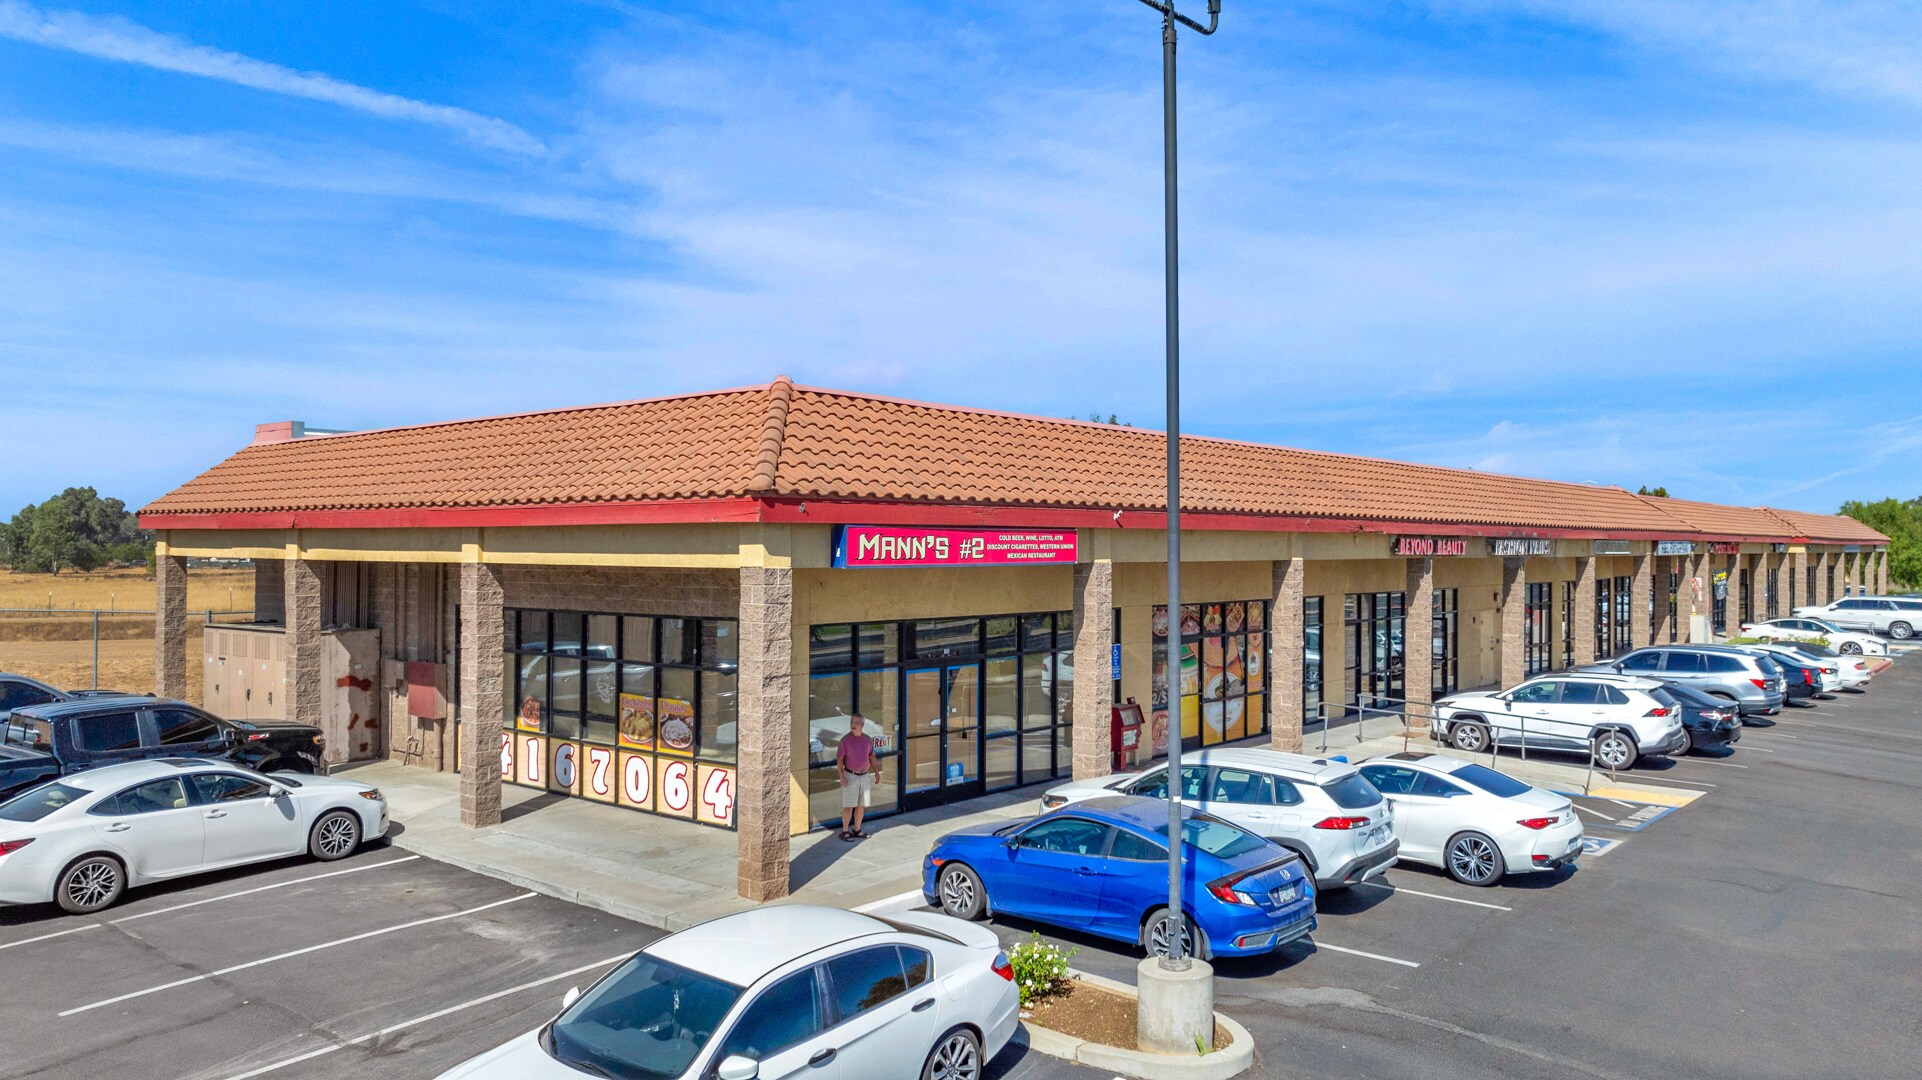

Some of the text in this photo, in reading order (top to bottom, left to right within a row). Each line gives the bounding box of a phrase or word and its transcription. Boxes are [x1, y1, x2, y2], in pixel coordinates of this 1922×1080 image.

[857, 533, 984, 560] MANN'S #2
[1400, 537, 1467, 556] BEYOND BEAUTY
